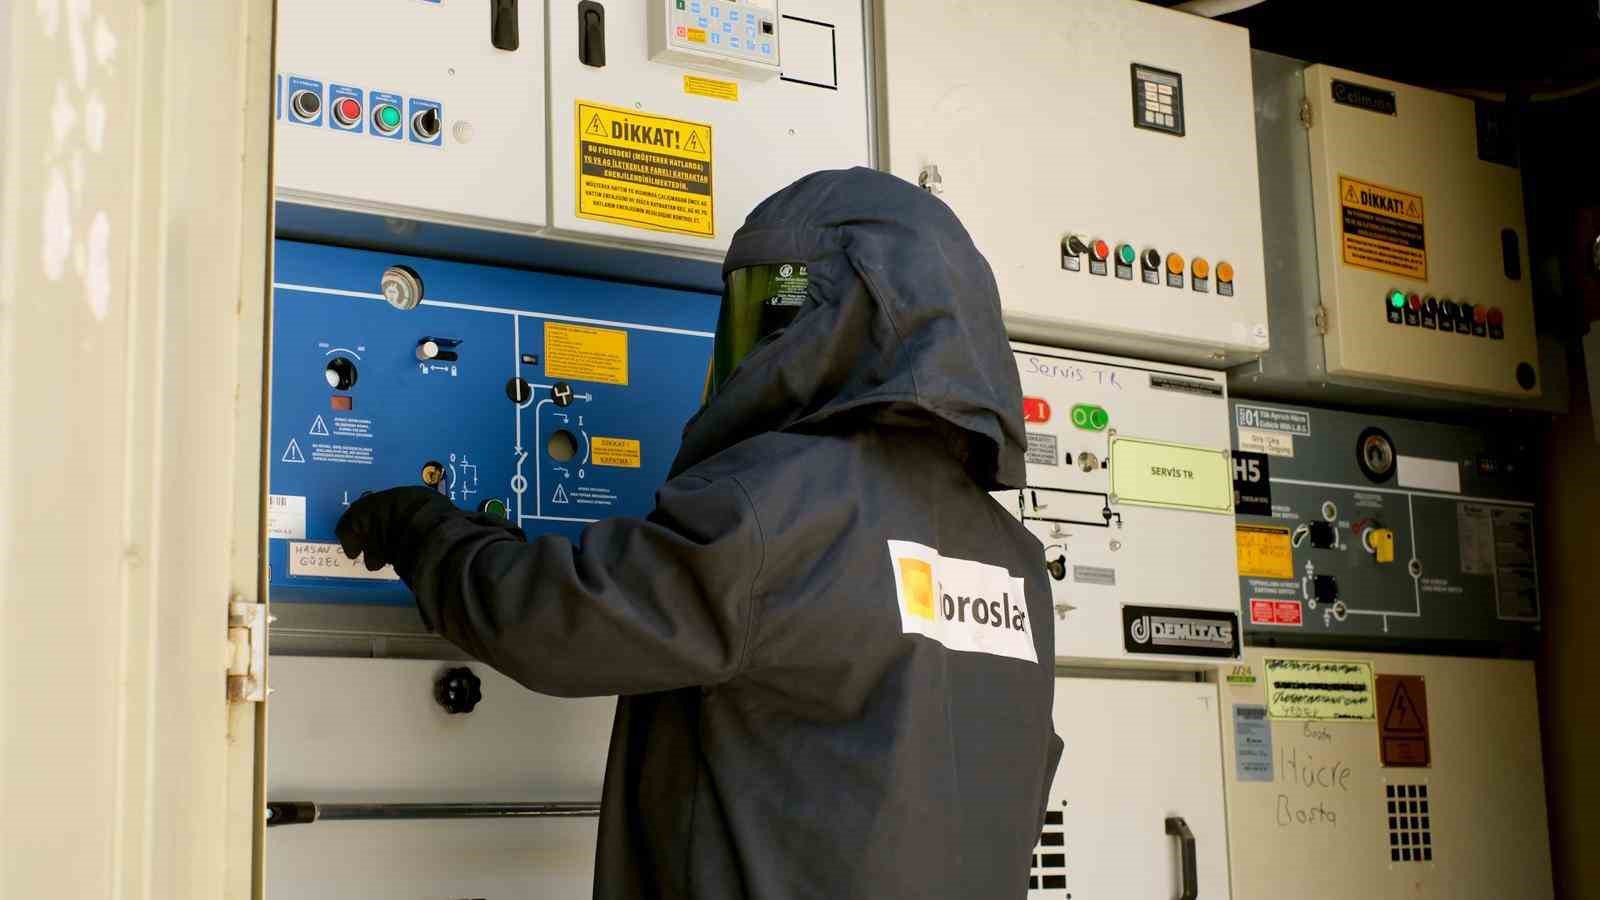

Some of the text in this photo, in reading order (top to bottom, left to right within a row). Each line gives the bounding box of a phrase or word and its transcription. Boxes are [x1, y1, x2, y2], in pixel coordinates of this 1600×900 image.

[611, 118, 680, 149] DİKKAT!
[1360, 188, 1405, 215] DİKKAT!
[1151, 466, 1194, 480] SERVİS TR
[1233, 457, 1261, 483] H5
[301, 557, 340, 568] GÜZEL
[1279, 744, 1352, 792] Hücre
